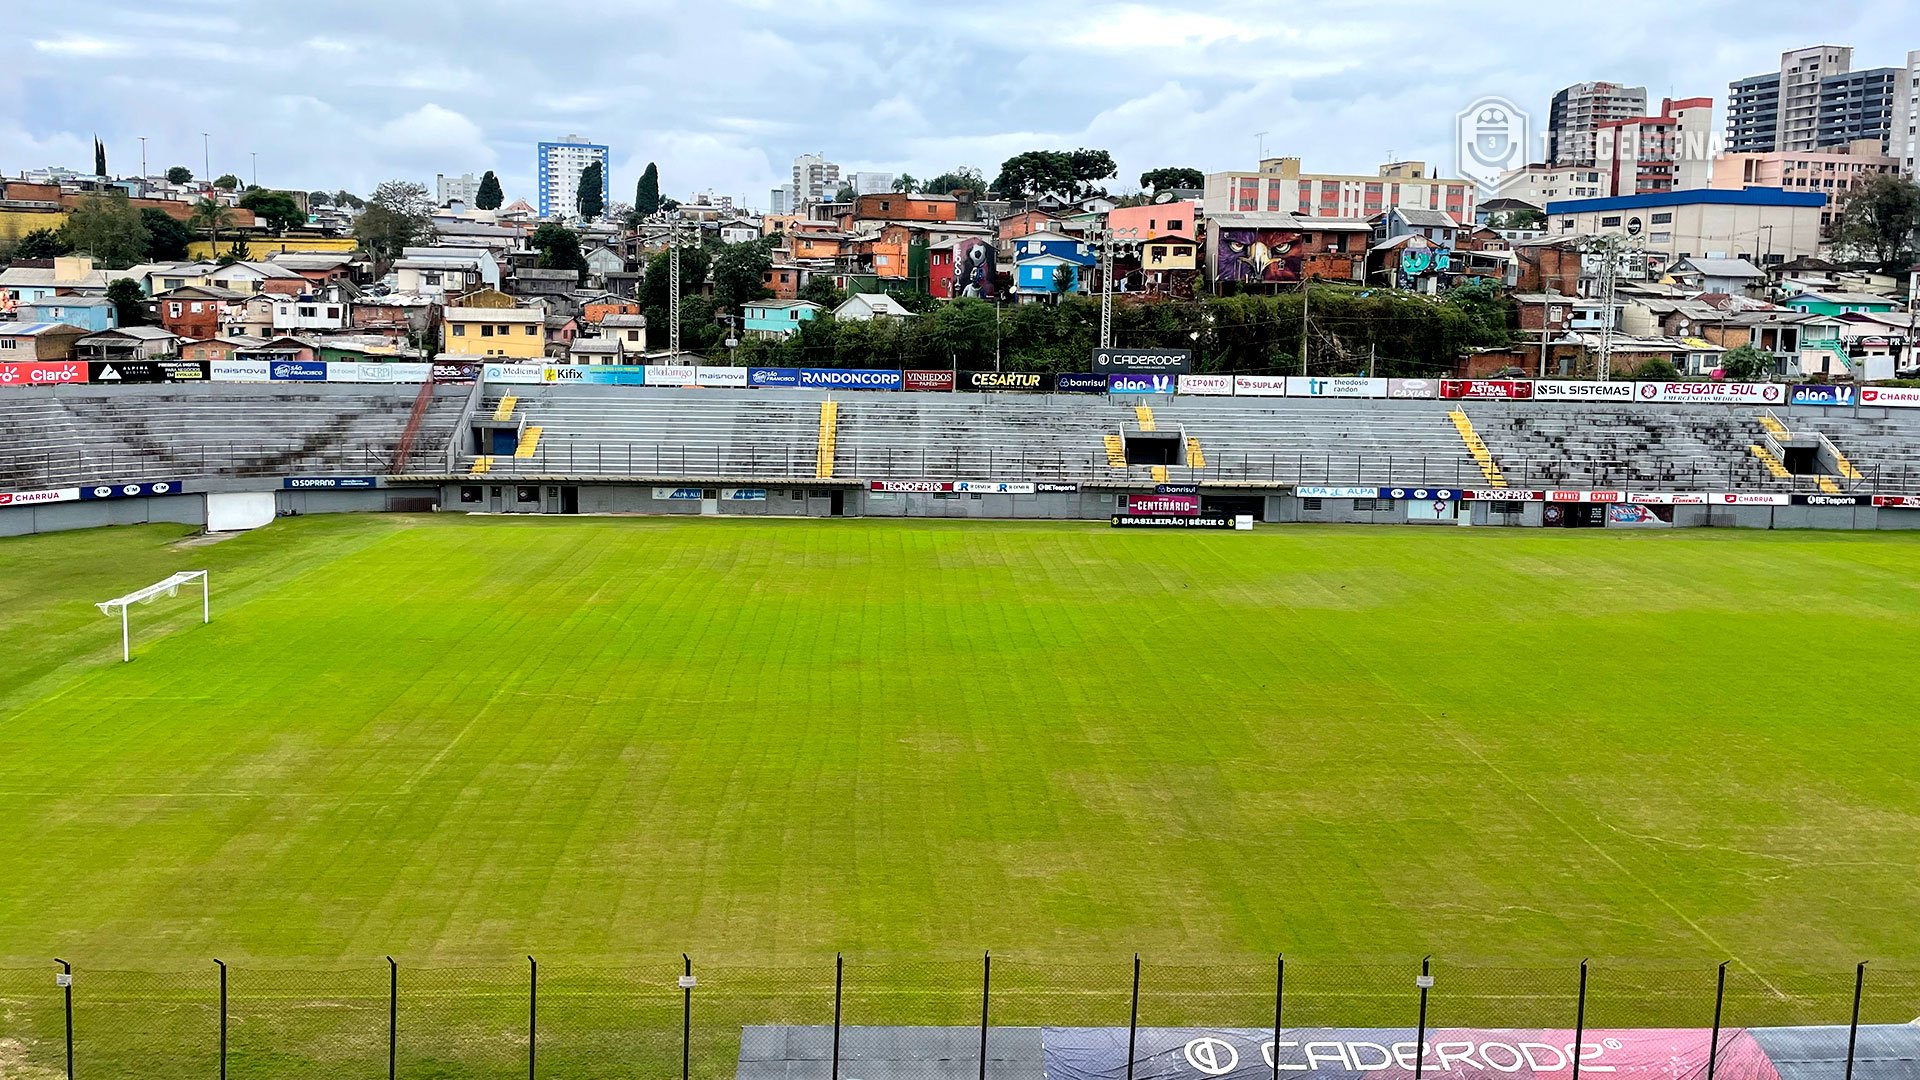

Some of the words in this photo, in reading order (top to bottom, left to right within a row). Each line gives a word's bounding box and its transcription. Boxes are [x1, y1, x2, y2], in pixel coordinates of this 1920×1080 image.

[31, 366, 75, 381] Claro
[503, 367, 540, 375] Medicinal
[557, 369, 583, 378] Kifix
[801, 372, 900, 385] RANDONCORP
[907, 372, 952, 382] VINHEDOS
[971, 373, 1041, 387] CESARTUR
[1070, 378, 1106, 387] banrisul
[1186, 379, 1225, 387] KIPONTO
[1309, 378, 1328, 394] tr
[1393, 390, 1431, 398] CAXIAS
[1469, 385, 1507, 393] ASTRAL
[1548, 385, 1566, 395] SIL
[1568, 385, 1630, 396] SISTEMAS
[1663, 383, 1726, 395] RESGATE
[1729, 384, 1758, 396] SUL
[1880, 393, 1920, 401] CHARRU
[299, 479, 336, 487] SOPRANO
[881, 482, 943, 491] TECNOFRIO
[15, 492, 60, 502] CHARRUA
[1473, 490, 1534, 500] TECNOFRIO
[1738, 495, 1774, 503] CHARRUA
[1137, 499, 1190, 511] CENTENÁRIO
[1121, 516, 1184, 525] BRASILEIRÃO
[1188, 517, 1216, 526] SÉRIE
